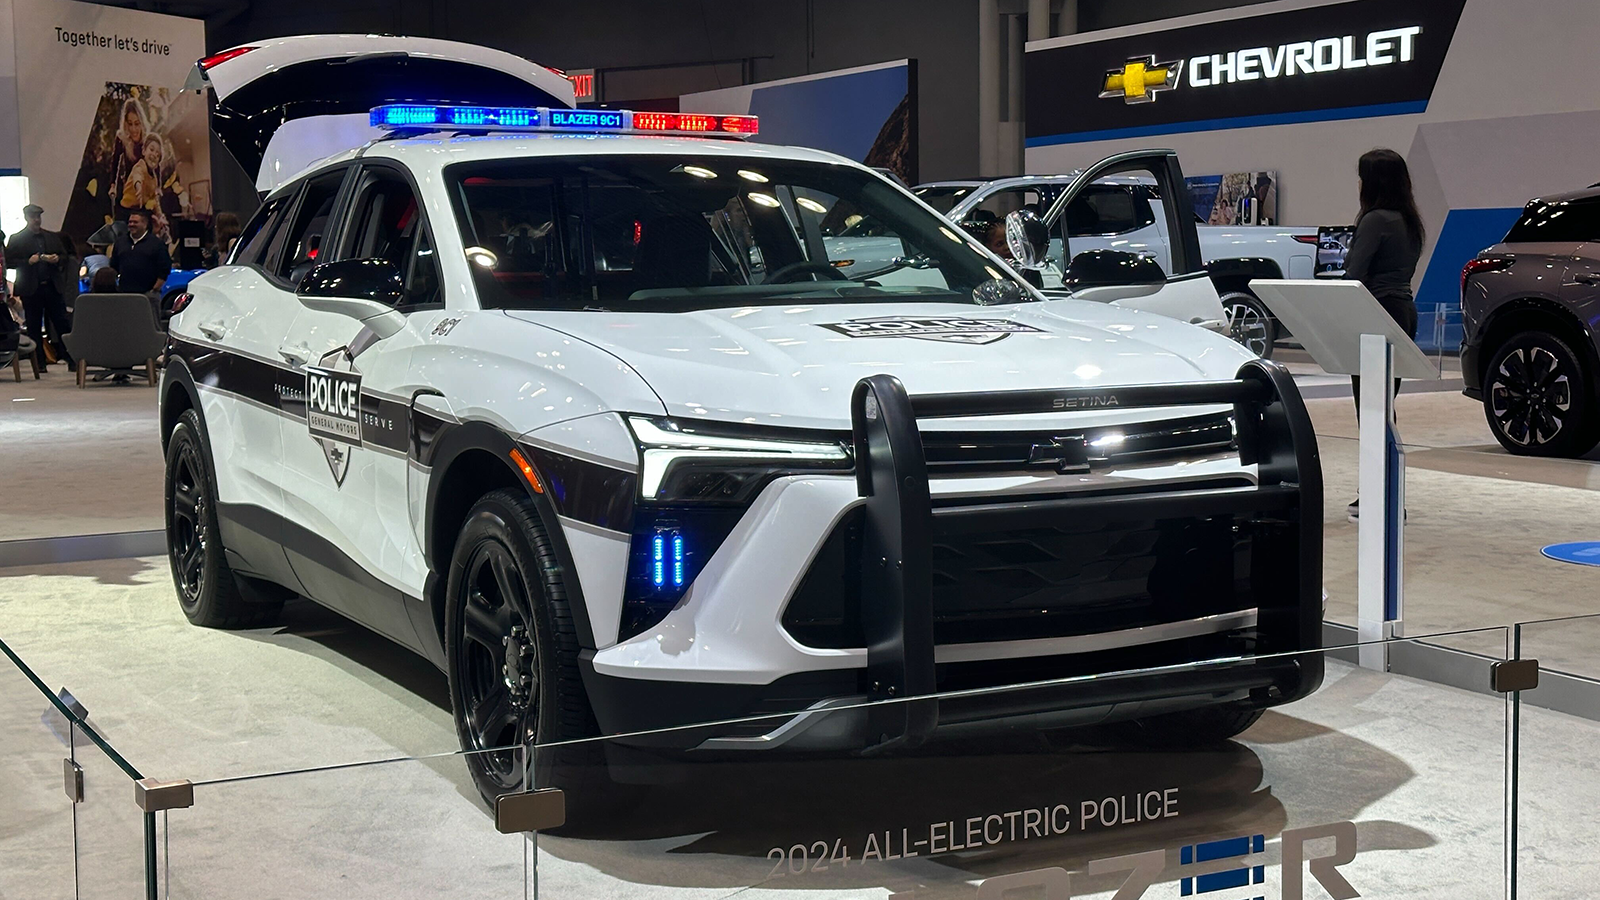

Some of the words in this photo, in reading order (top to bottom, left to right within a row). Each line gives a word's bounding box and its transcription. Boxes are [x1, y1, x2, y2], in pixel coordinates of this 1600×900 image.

[55, 26, 112, 47] Together
[114, 34, 139, 52] let's
[141, 39, 170, 56] drive
[1189, 26, 1423, 88] CHEVROLET
[553, 113, 598, 125] BLAZER
[600, 115, 620, 126] 9C1
[835, 319, 1016, 332] POLICE
[274, 383, 302, 400] PROTECT
[310, 375, 357, 418] POLICE
[1052, 395, 1119, 408] SETINA
[311, 416, 334, 429] GENERAL
[336, 423, 357, 435] MOTORS
[365, 413, 393, 430] SERVE
[766, 838, 851, 879] 2024
[861, 804, 1071, 866] ALL-ELECTRIC
[1081, 787, 1179, 831] POLICE
